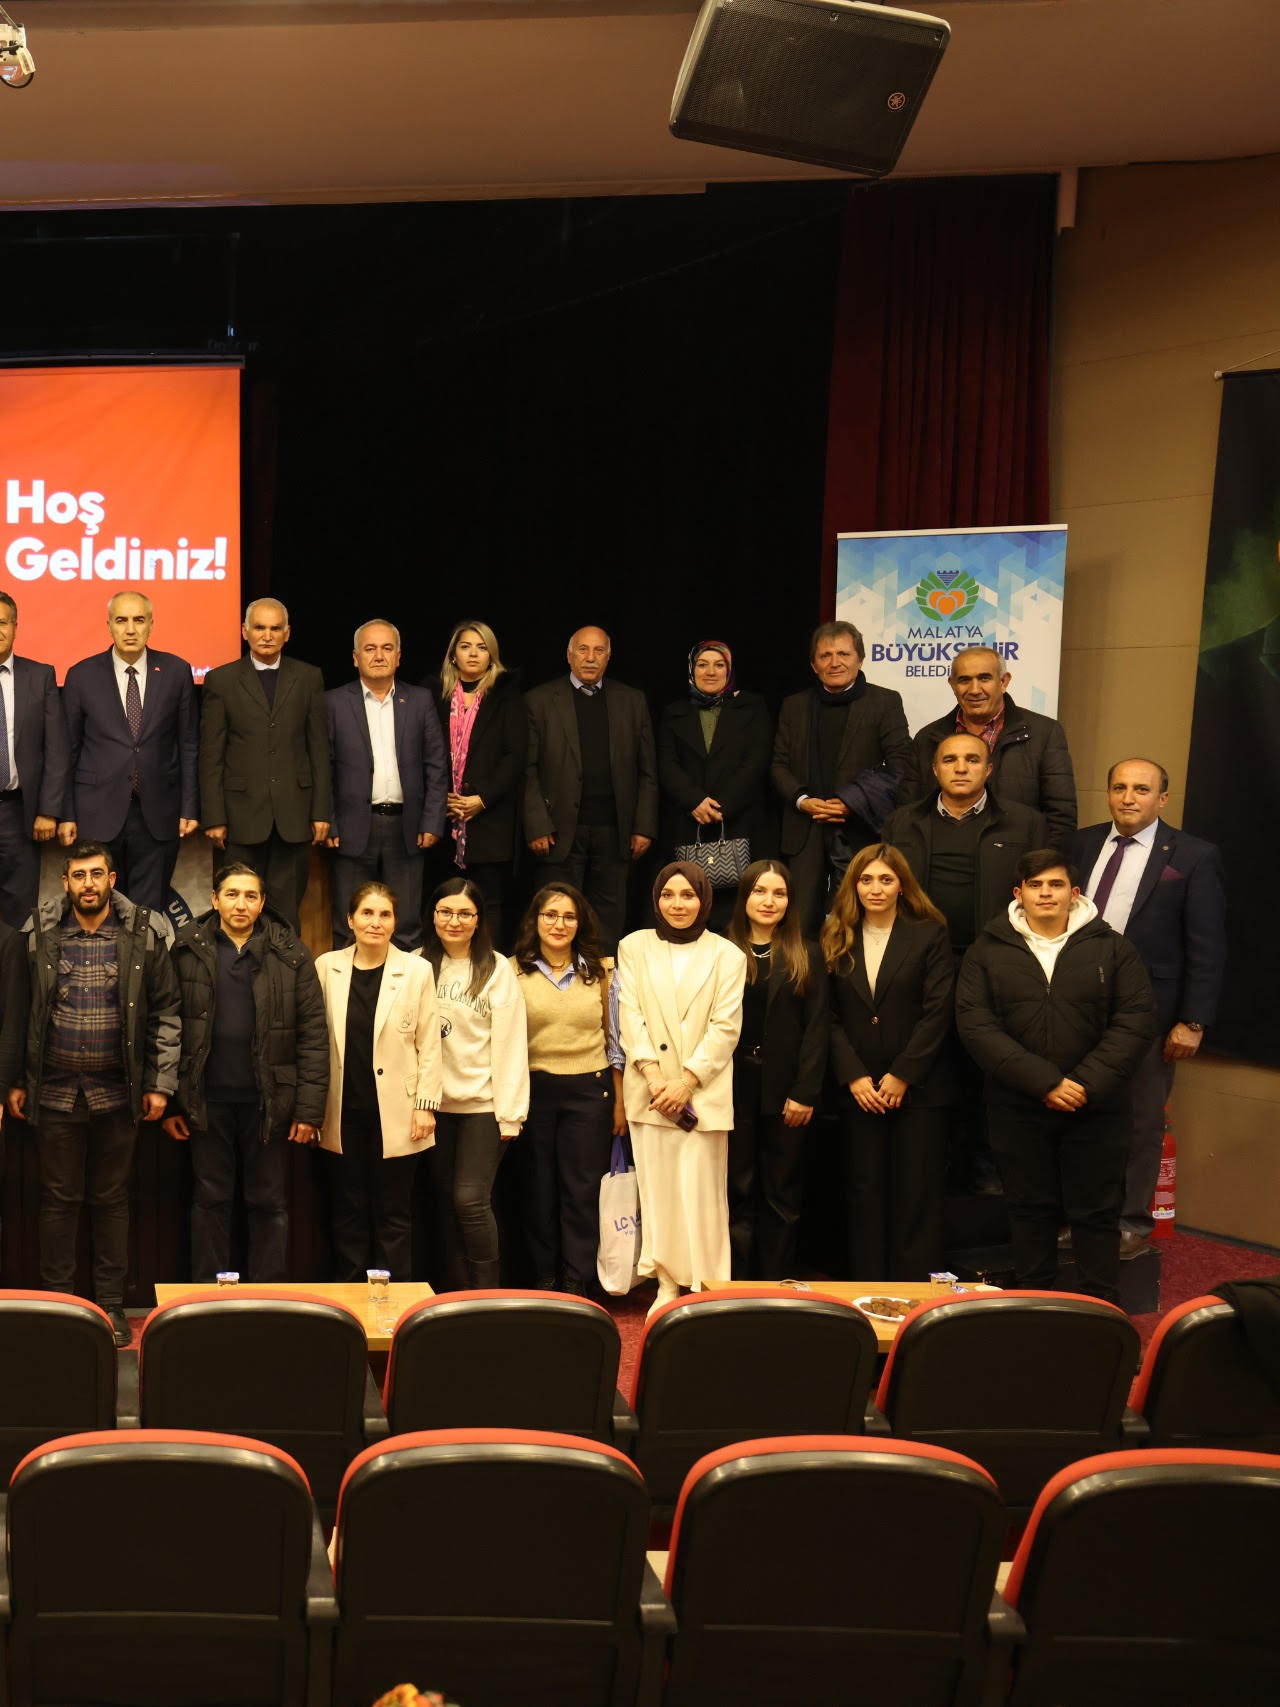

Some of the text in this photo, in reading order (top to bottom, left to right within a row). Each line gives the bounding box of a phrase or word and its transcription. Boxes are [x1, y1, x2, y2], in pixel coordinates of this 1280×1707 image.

[6, 479, 105, 535] Hoş
[5, 537, 228, 581] Geldiniz!
[907, 626, 983, 638] MALATYA
[871, 641, 1020, 662] BÜYÜKİR
[905, 665, 952, 677] BELEDİ
